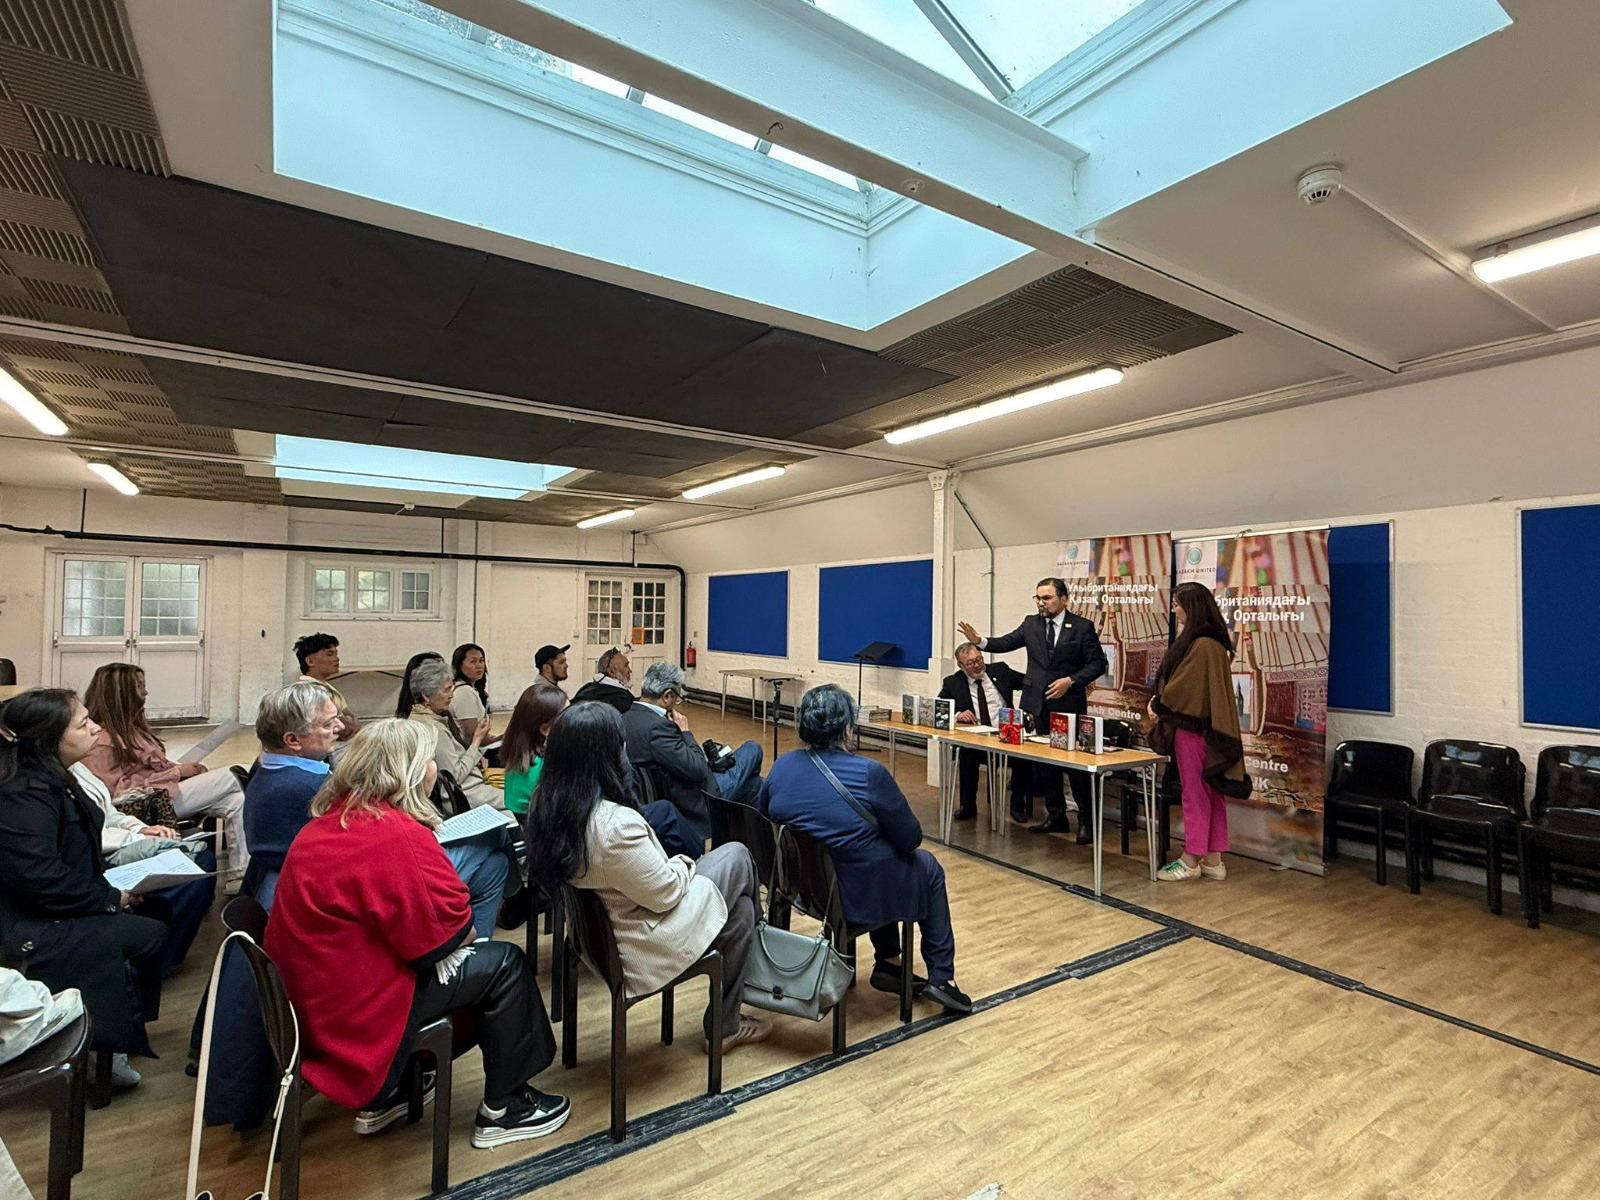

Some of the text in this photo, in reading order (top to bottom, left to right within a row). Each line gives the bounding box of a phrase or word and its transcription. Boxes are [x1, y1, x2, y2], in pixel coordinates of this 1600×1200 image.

[1067, 583, 1158, 594] Улыбританиядағы
[1069, 595, 1154, 605] Қазақ Орталығы
[1214, 594, 1311, 609] британиядағы
[1233, 609, 1305, 624] Орталығы
[1108, 708, 1141, 720] Centre
